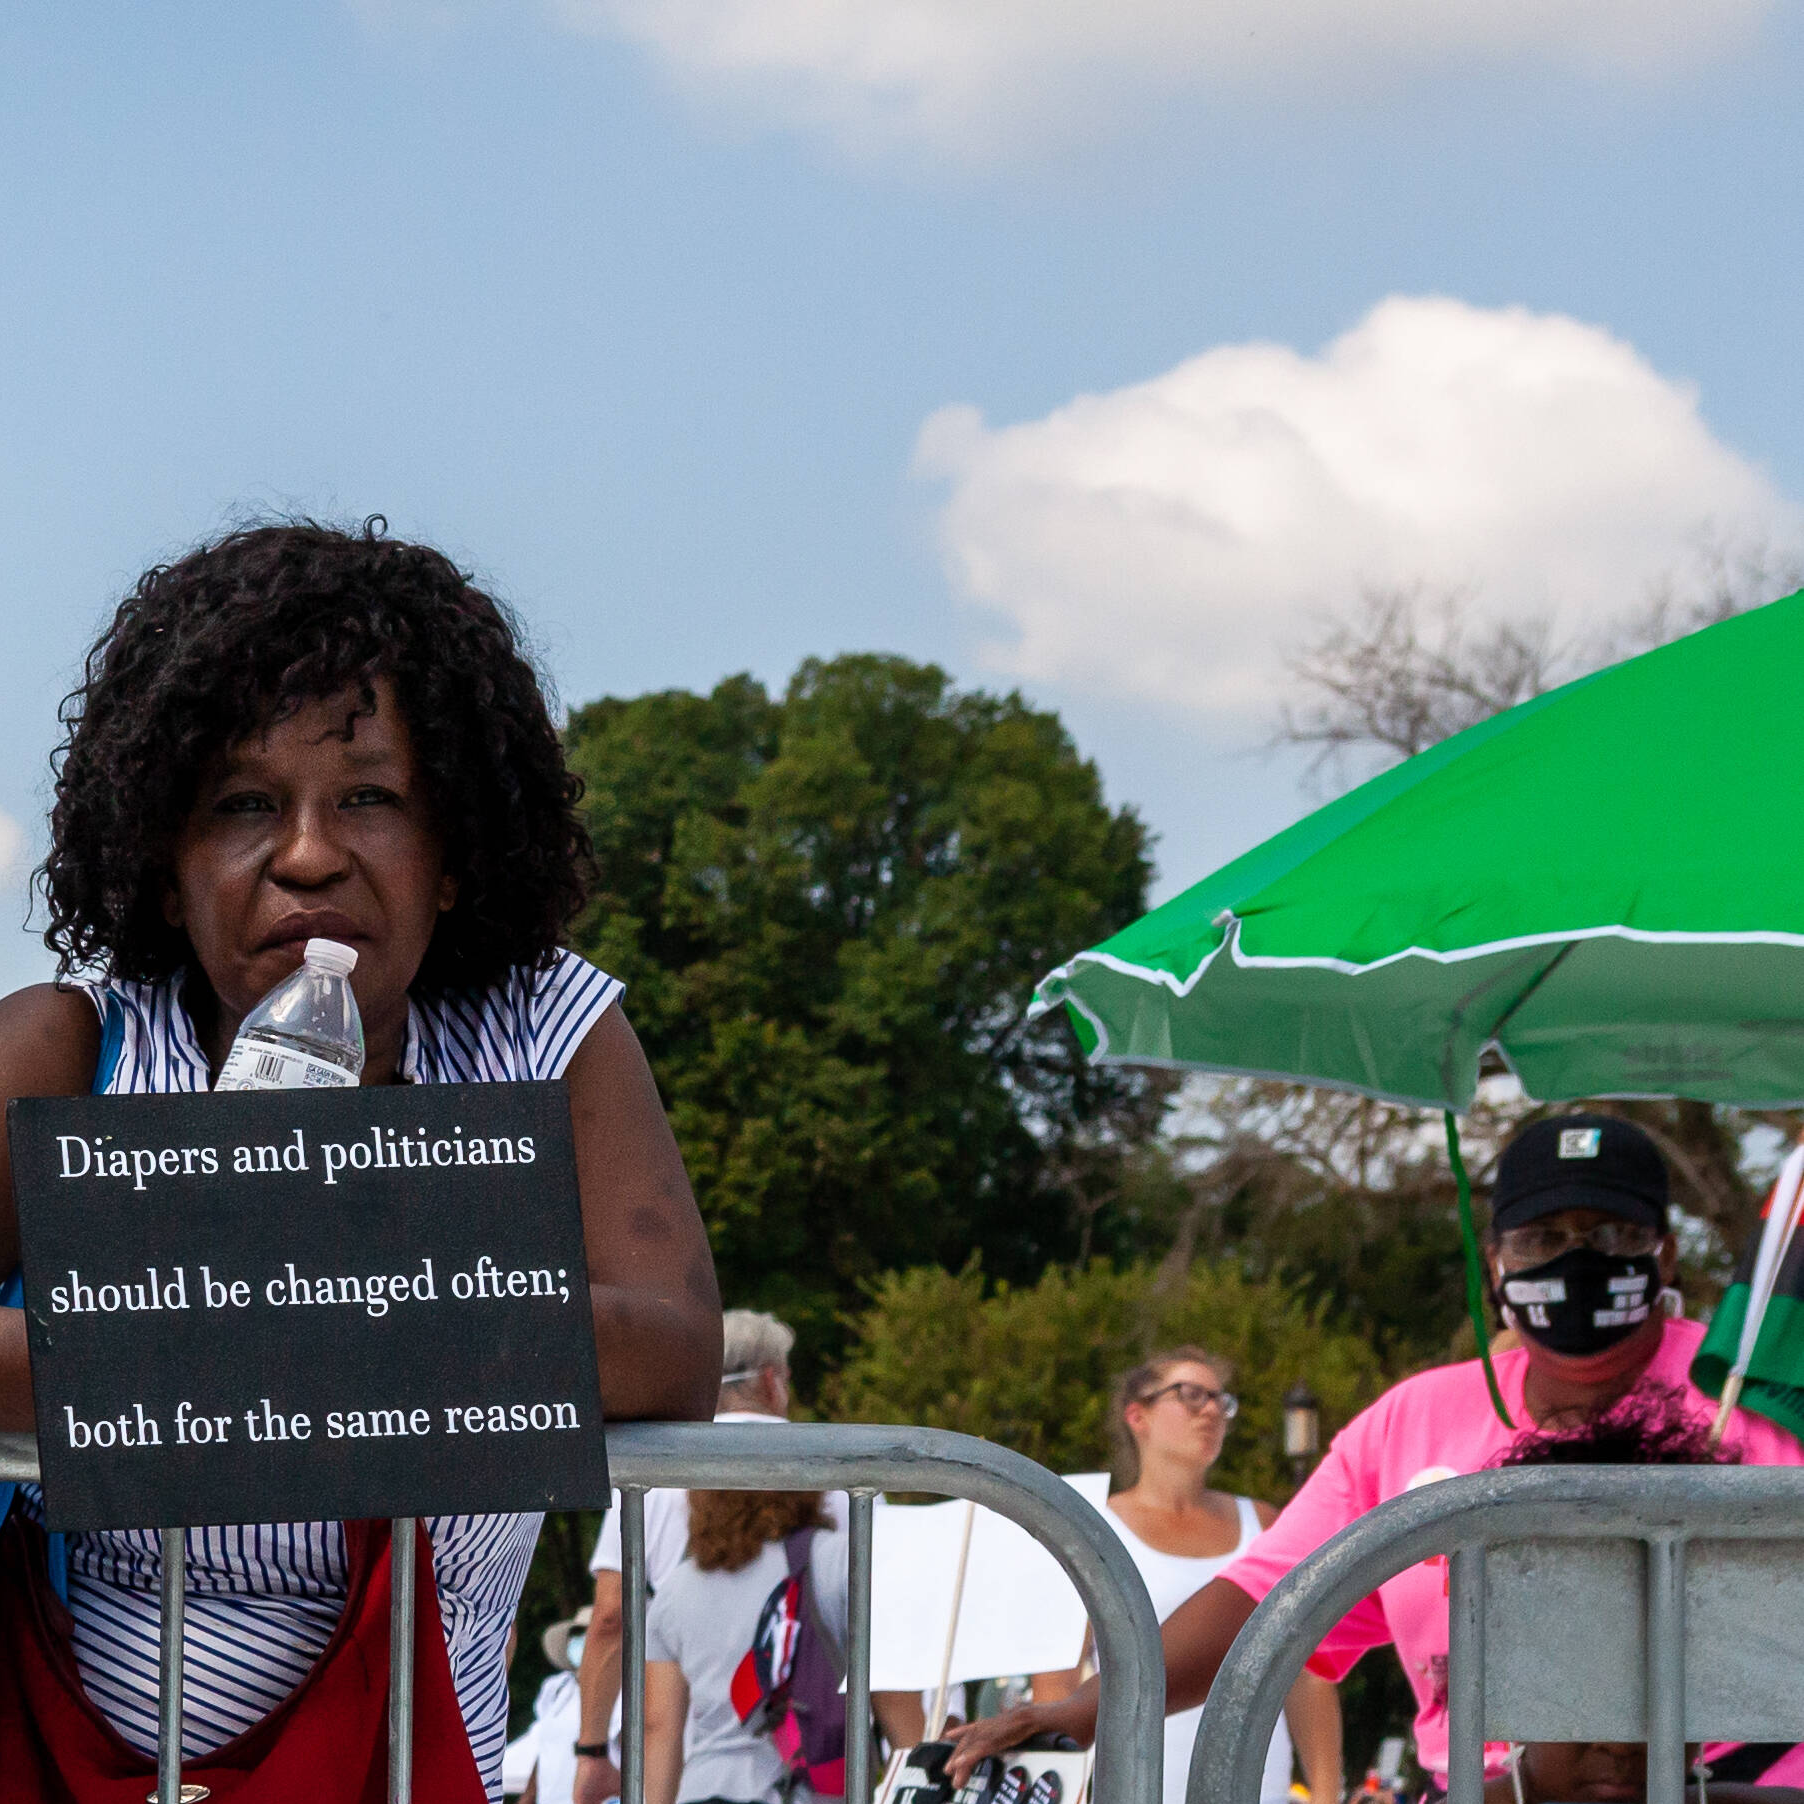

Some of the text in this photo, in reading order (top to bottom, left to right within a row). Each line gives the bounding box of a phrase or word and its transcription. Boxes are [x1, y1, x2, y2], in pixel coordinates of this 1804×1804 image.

[56, 1126, 537, 1191] Diapers and politicians
[50, 1255, 571, 1317] should be changed often;
[63, 1398, 581, 1449] both for the same reason
